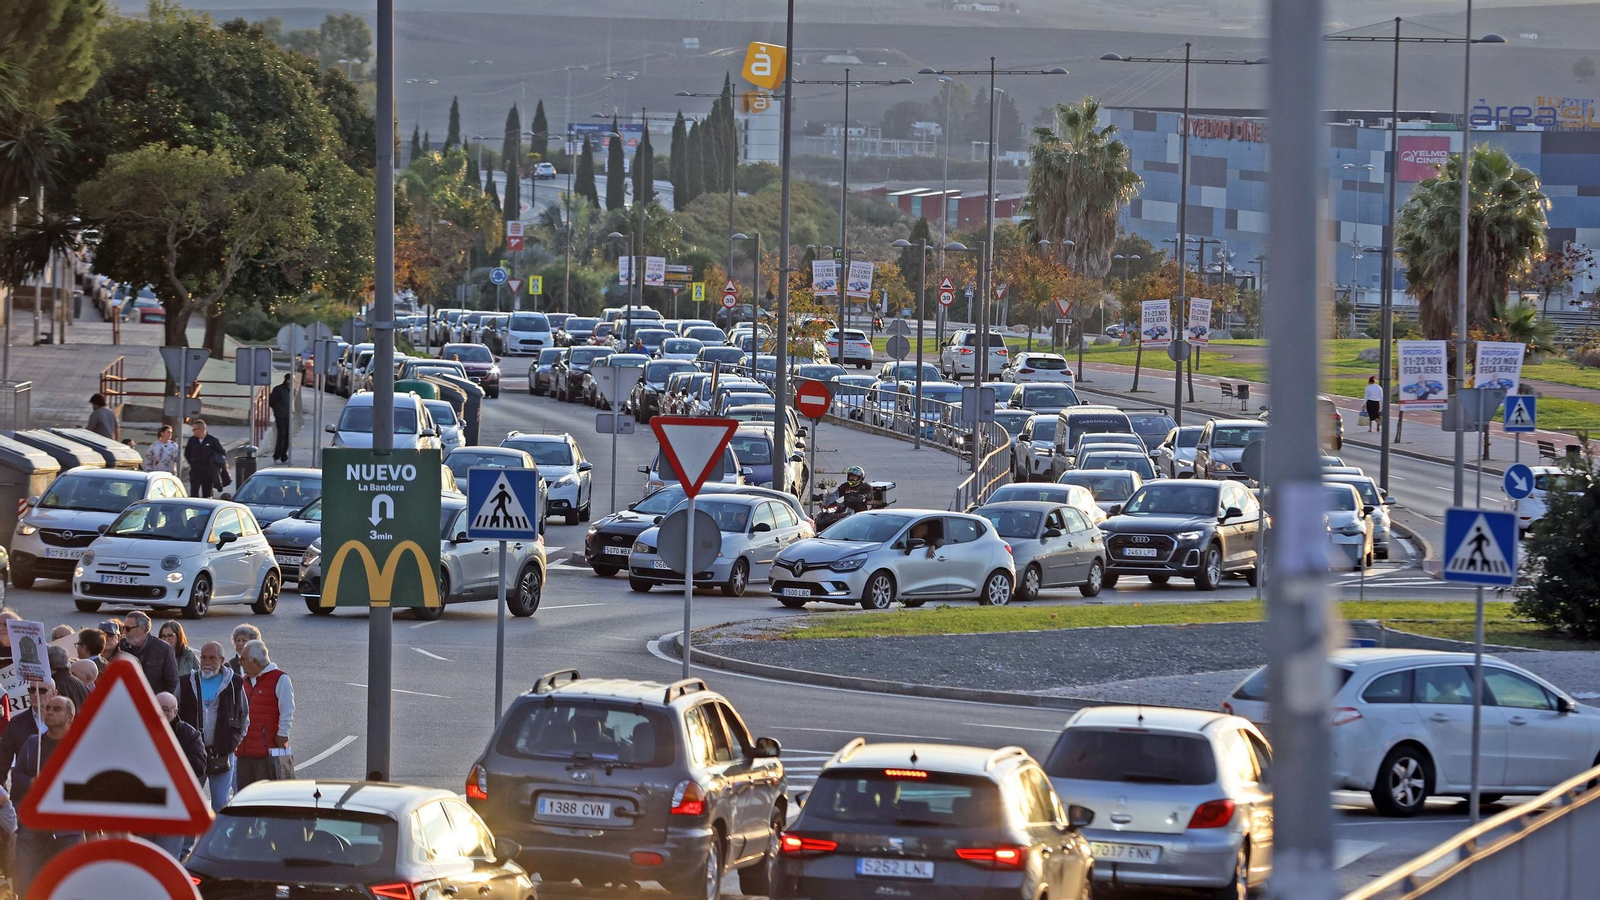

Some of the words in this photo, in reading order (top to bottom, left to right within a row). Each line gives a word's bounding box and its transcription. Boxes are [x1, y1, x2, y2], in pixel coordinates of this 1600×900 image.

[1190, 118, 1231, 139] YELMO
[1403, 357, 1426, 365] 21-23
[1427, 356, 1442, 365] NOV
[1480, 357, 1502, 365] 21-23
[1503, 357, 1518, 365] NOV
[1403, 366, 1422, 374] IFECA
[1423, 366, 1443, 374] JEREZ
[346, 464, 417, 481] NUEVO
[358, 483, 368, 491] La
[370, 483, 405, 491] Bandera
[369, 530, 393, 540] 3min
[50, 549, 68, 557] 0789
[606, 546, 620, 554] 5070
[105, 575, 123, 583] 7715
[550, 801, 577, 814] 1388
[582, 803, 605, 816] CVN
[1095, 844, 1124, 857] 7017
[1128, 847, 1153, 859] FNK
[864, 861, 899, 874] 5252
[904, 862, 930, 876] LNL
